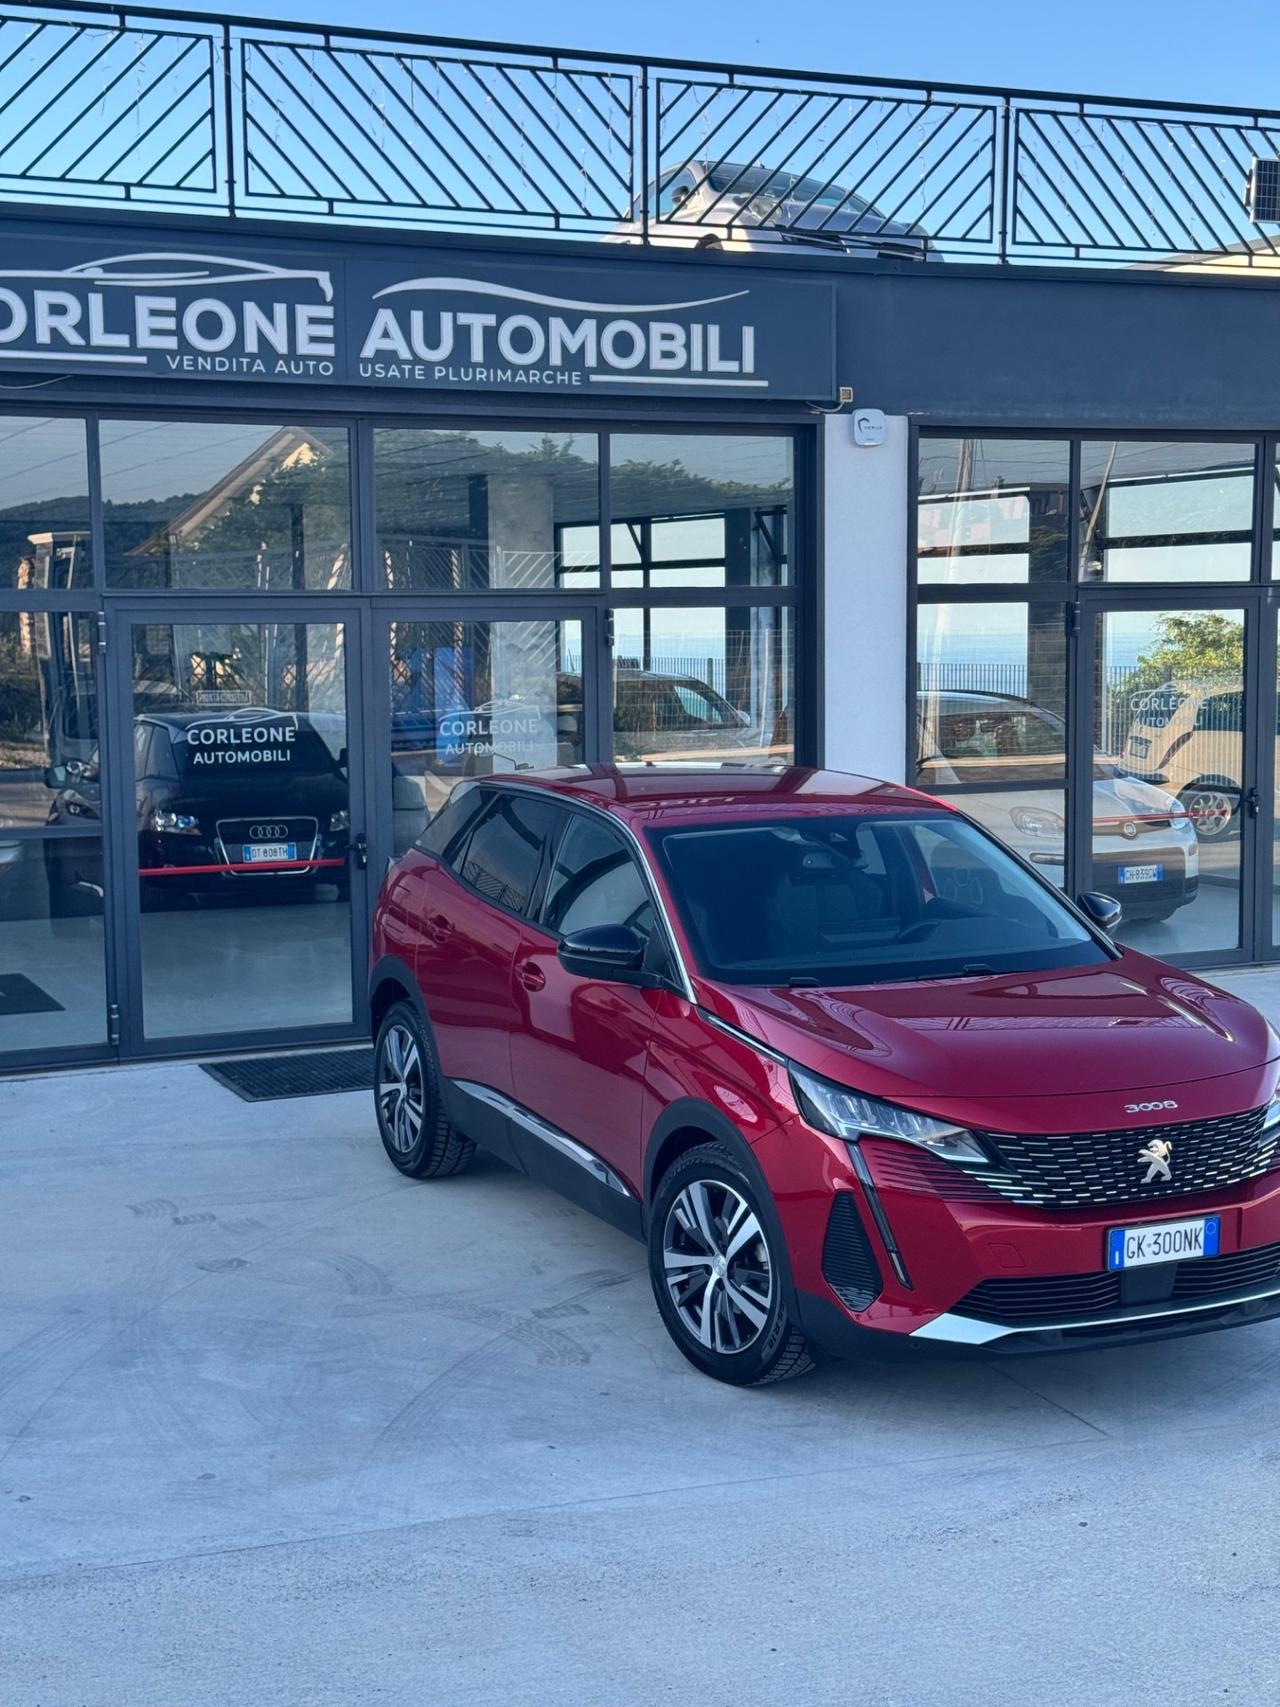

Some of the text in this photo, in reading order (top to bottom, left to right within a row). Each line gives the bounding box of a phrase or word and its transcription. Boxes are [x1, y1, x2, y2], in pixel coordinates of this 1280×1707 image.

[359, 308, 755, 374] AUTOMOBILI
[166, 354, 334, 377] VENDITA AUTO
[359, 362, 583, 386] USATE PLURIMARCHE
[187, 727, 296, 746] CORLEONE
[439, 718, 539, 737] CORLEONE
[193, 750, 291, 765] AUTOMOBILI
[1123, 1100, 1179, 1114] 3008
